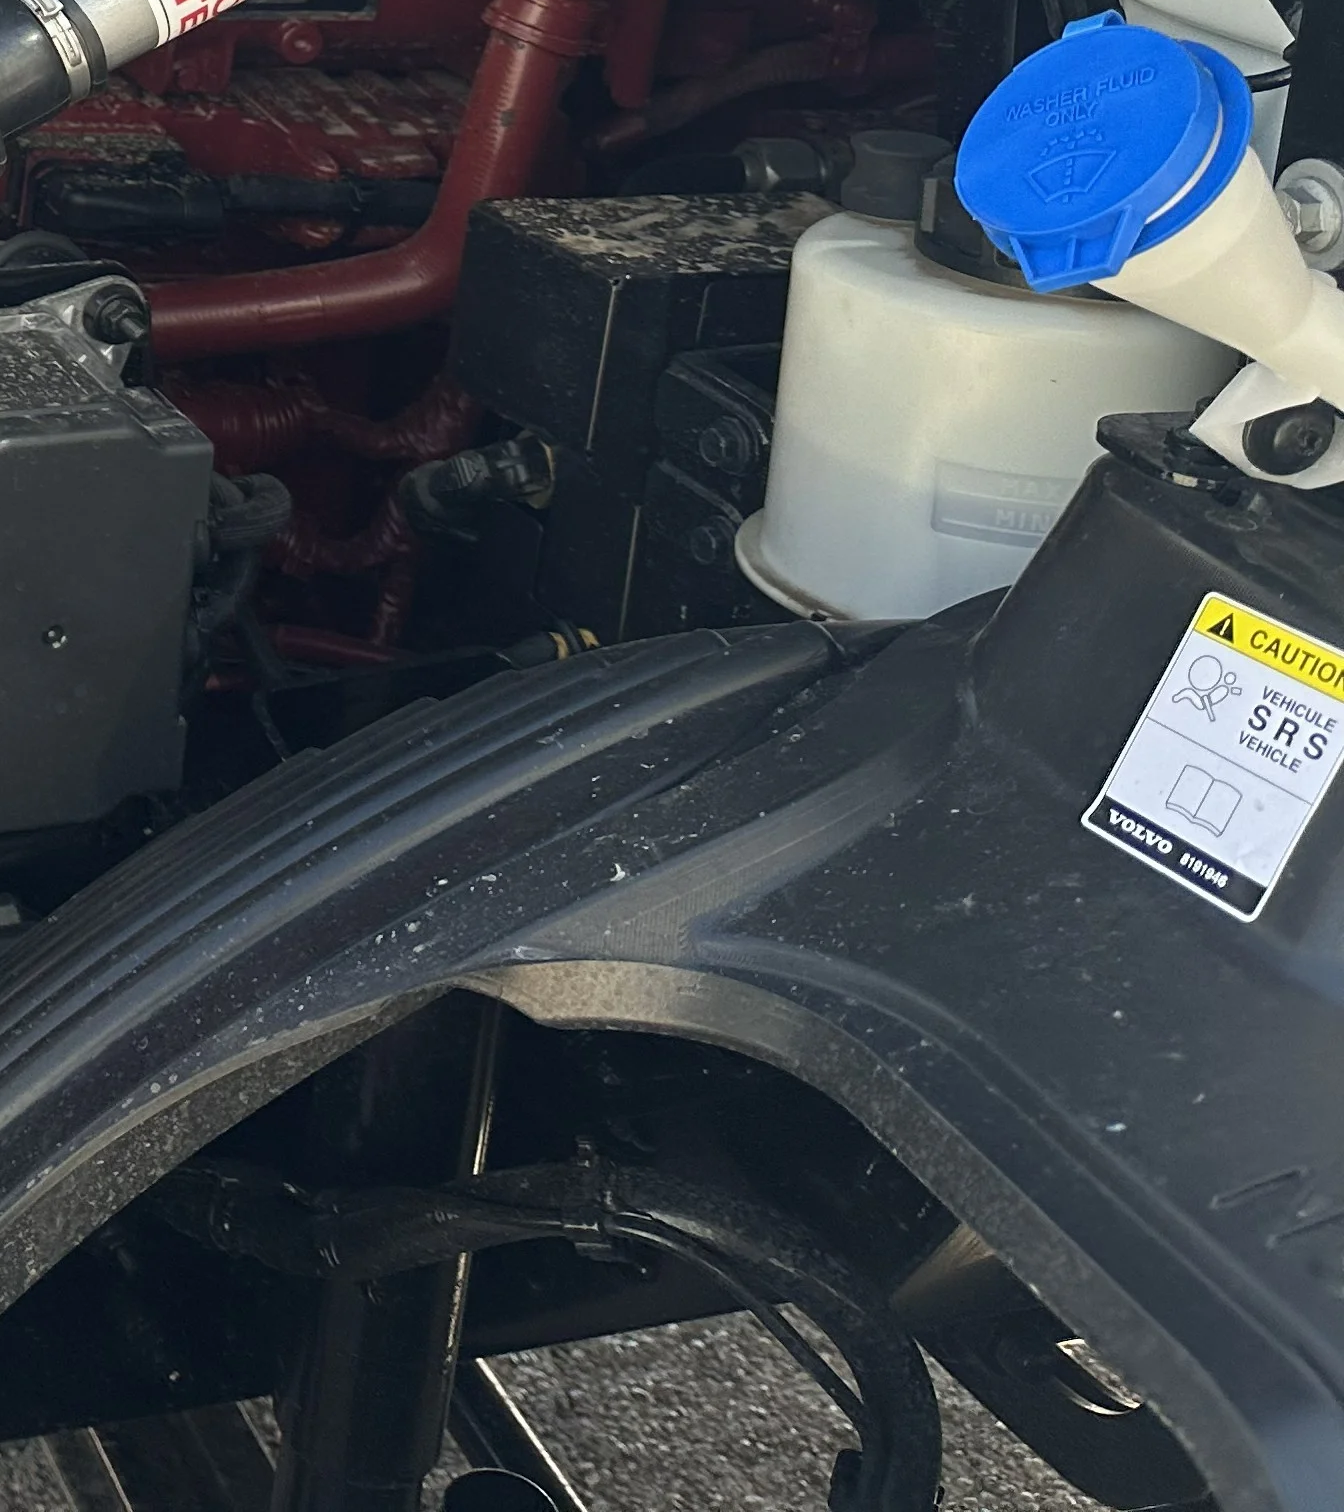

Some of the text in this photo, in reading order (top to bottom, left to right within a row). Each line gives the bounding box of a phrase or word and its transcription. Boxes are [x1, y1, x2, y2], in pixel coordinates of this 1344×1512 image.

[1004, 66, 1156, 122] WASHER FLUID
[1046, 103, 1098, 128] ONLY
[995, 508, 1049, 532] MIN
[1262, 685, 1338, 734] VEHICULE
[1238, 730, 1303, 774] VEHICLE
[1108, 808, 1174, 855] VOLVO
